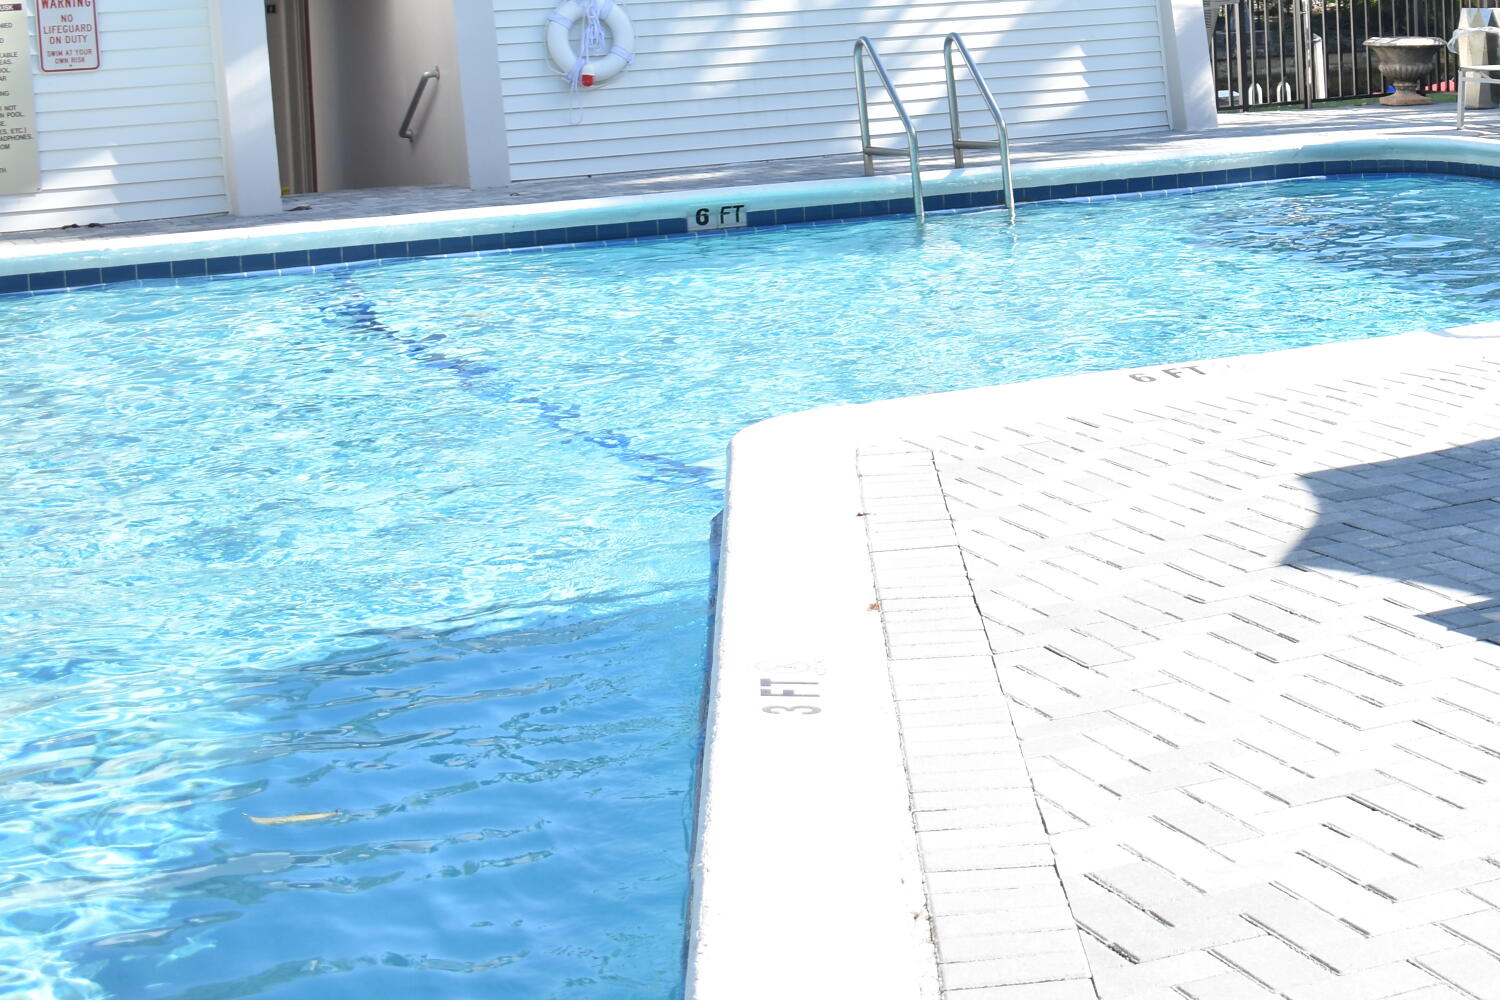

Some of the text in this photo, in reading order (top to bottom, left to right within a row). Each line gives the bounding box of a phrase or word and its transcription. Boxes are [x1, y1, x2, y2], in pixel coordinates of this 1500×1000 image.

[61, 14, 73, 22] NO
[43, 24, 92, 34] LIFEGUARD
[49, 35, 88, 44] ON DUTY
[696, 204, 745, 226] 6 FT
[1128, 365, 1207, 383] 6 FT
[760, 678, 822, 715] 3 FT
